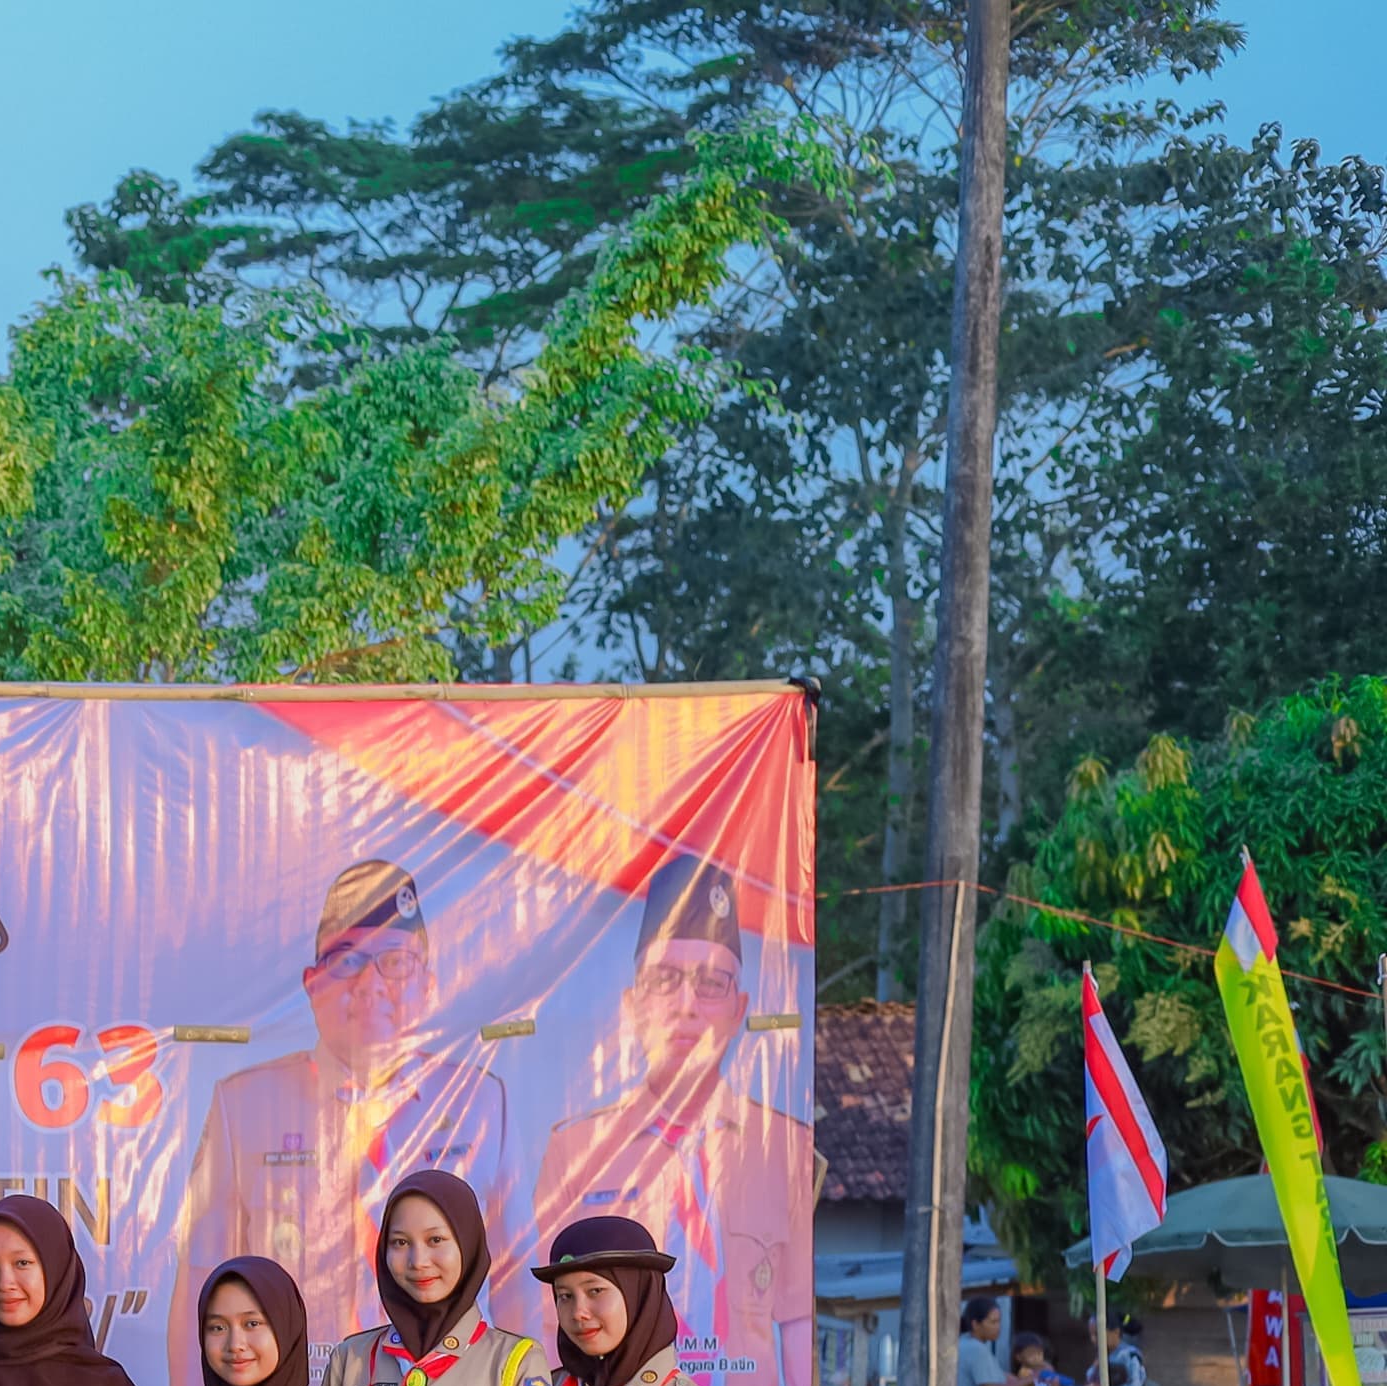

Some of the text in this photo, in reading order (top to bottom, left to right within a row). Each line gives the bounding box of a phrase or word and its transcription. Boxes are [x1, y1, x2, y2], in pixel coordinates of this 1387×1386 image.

[14, 1024, 163, 1128] 63
[679, 1358, 756, 1373] egara Batin
